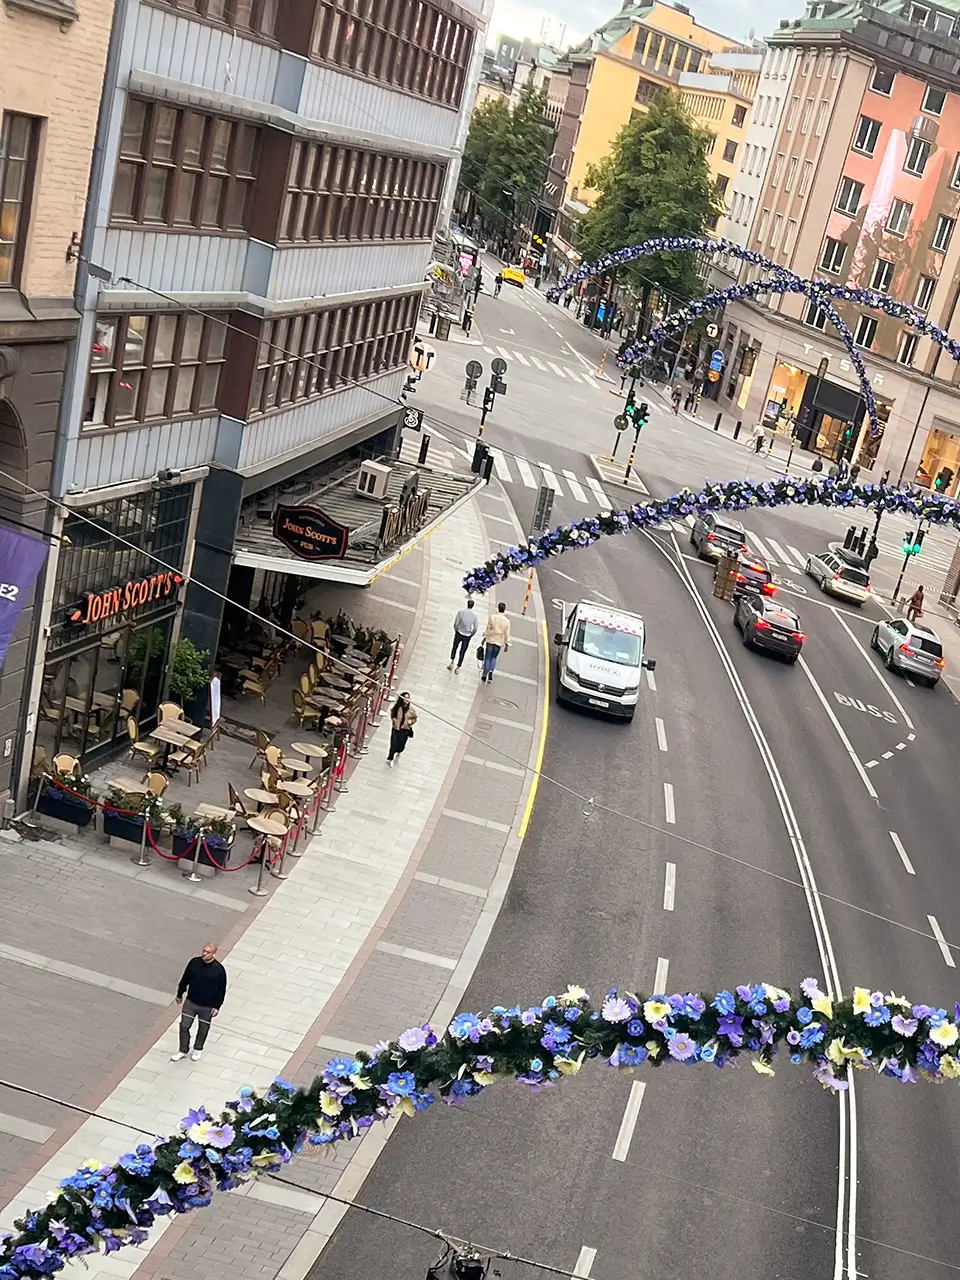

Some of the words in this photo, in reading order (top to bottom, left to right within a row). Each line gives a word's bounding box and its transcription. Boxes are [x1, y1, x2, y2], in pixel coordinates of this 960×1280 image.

[803, 343, 884, 385] TESA
[82, 586, 122, 624] JOHN
[122, 571, 172, 610] SCOTT'S
[833, 691, 898, 724] BUSS
